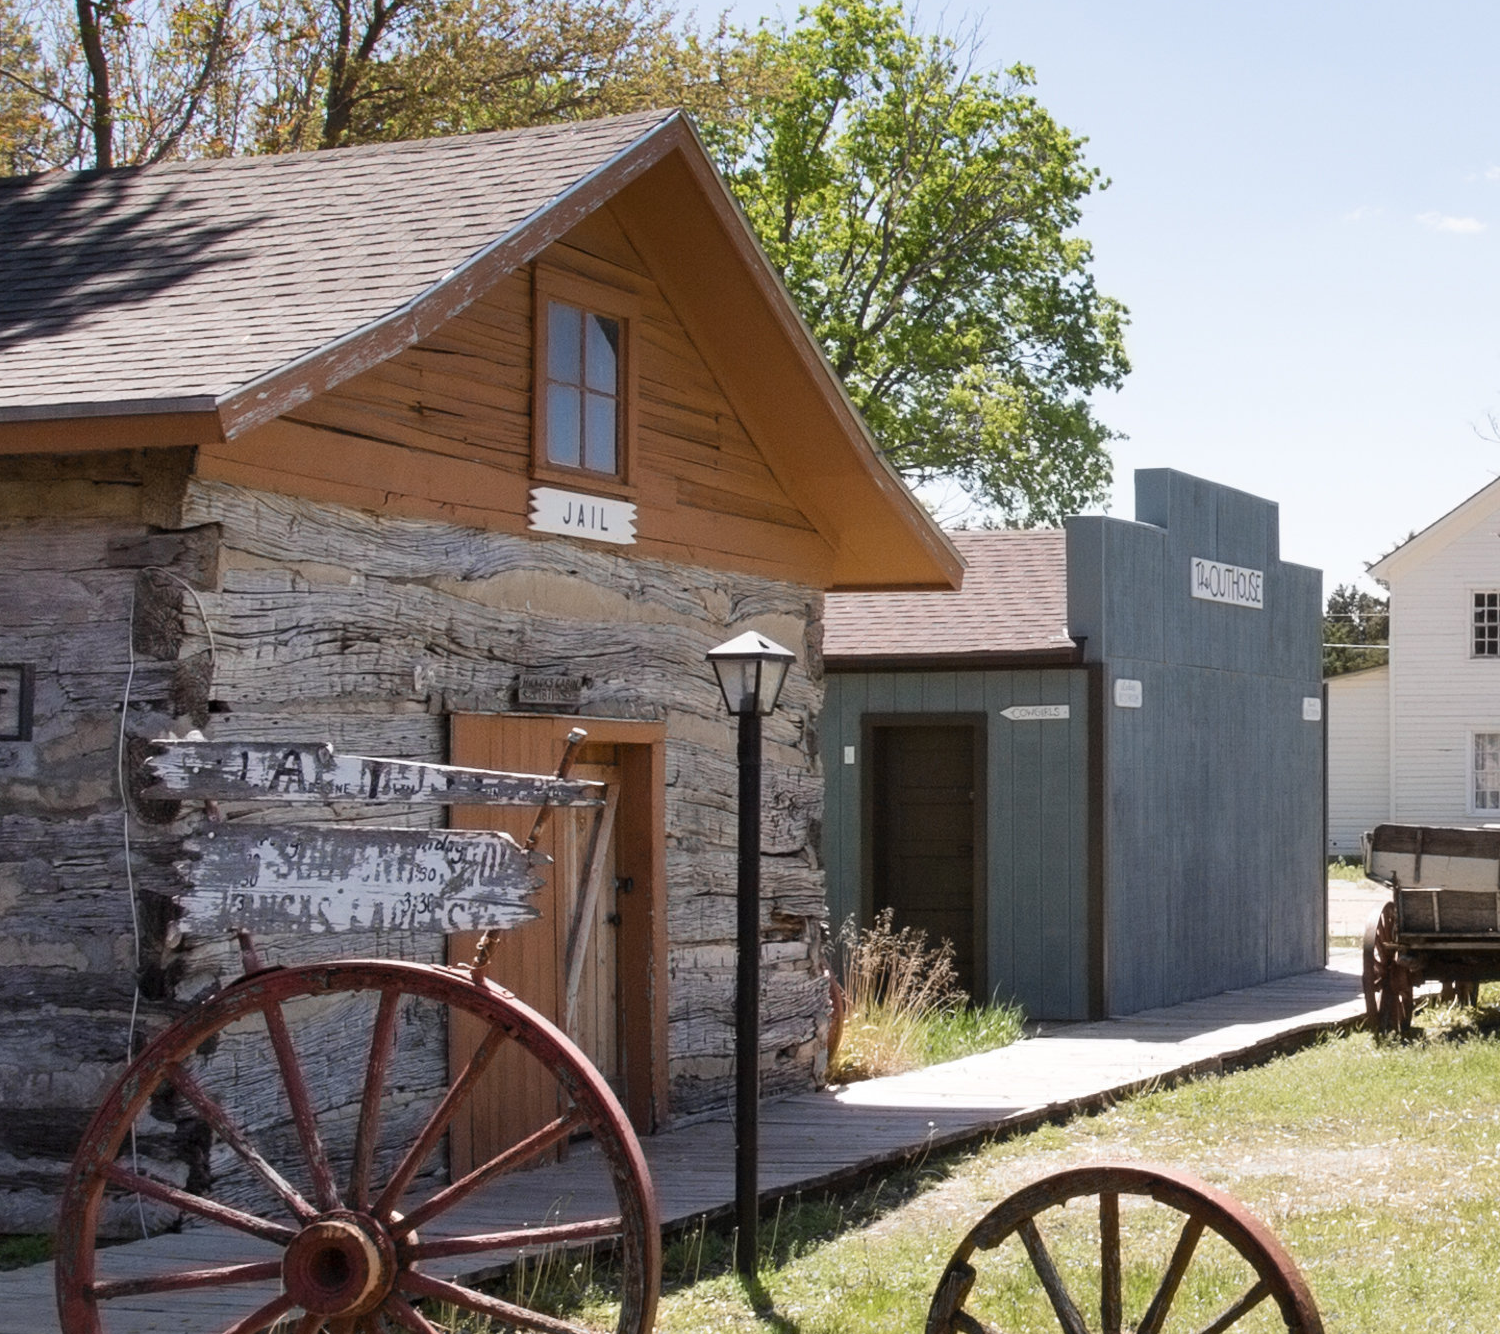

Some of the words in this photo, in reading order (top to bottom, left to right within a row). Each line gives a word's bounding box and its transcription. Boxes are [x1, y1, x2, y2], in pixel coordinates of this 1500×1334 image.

[562, 501, 608, 531] JAIL
[1209, 565, 1261, 603] OUTHOUSE
[1010, 706, 1060, 718] COWGIRLS
